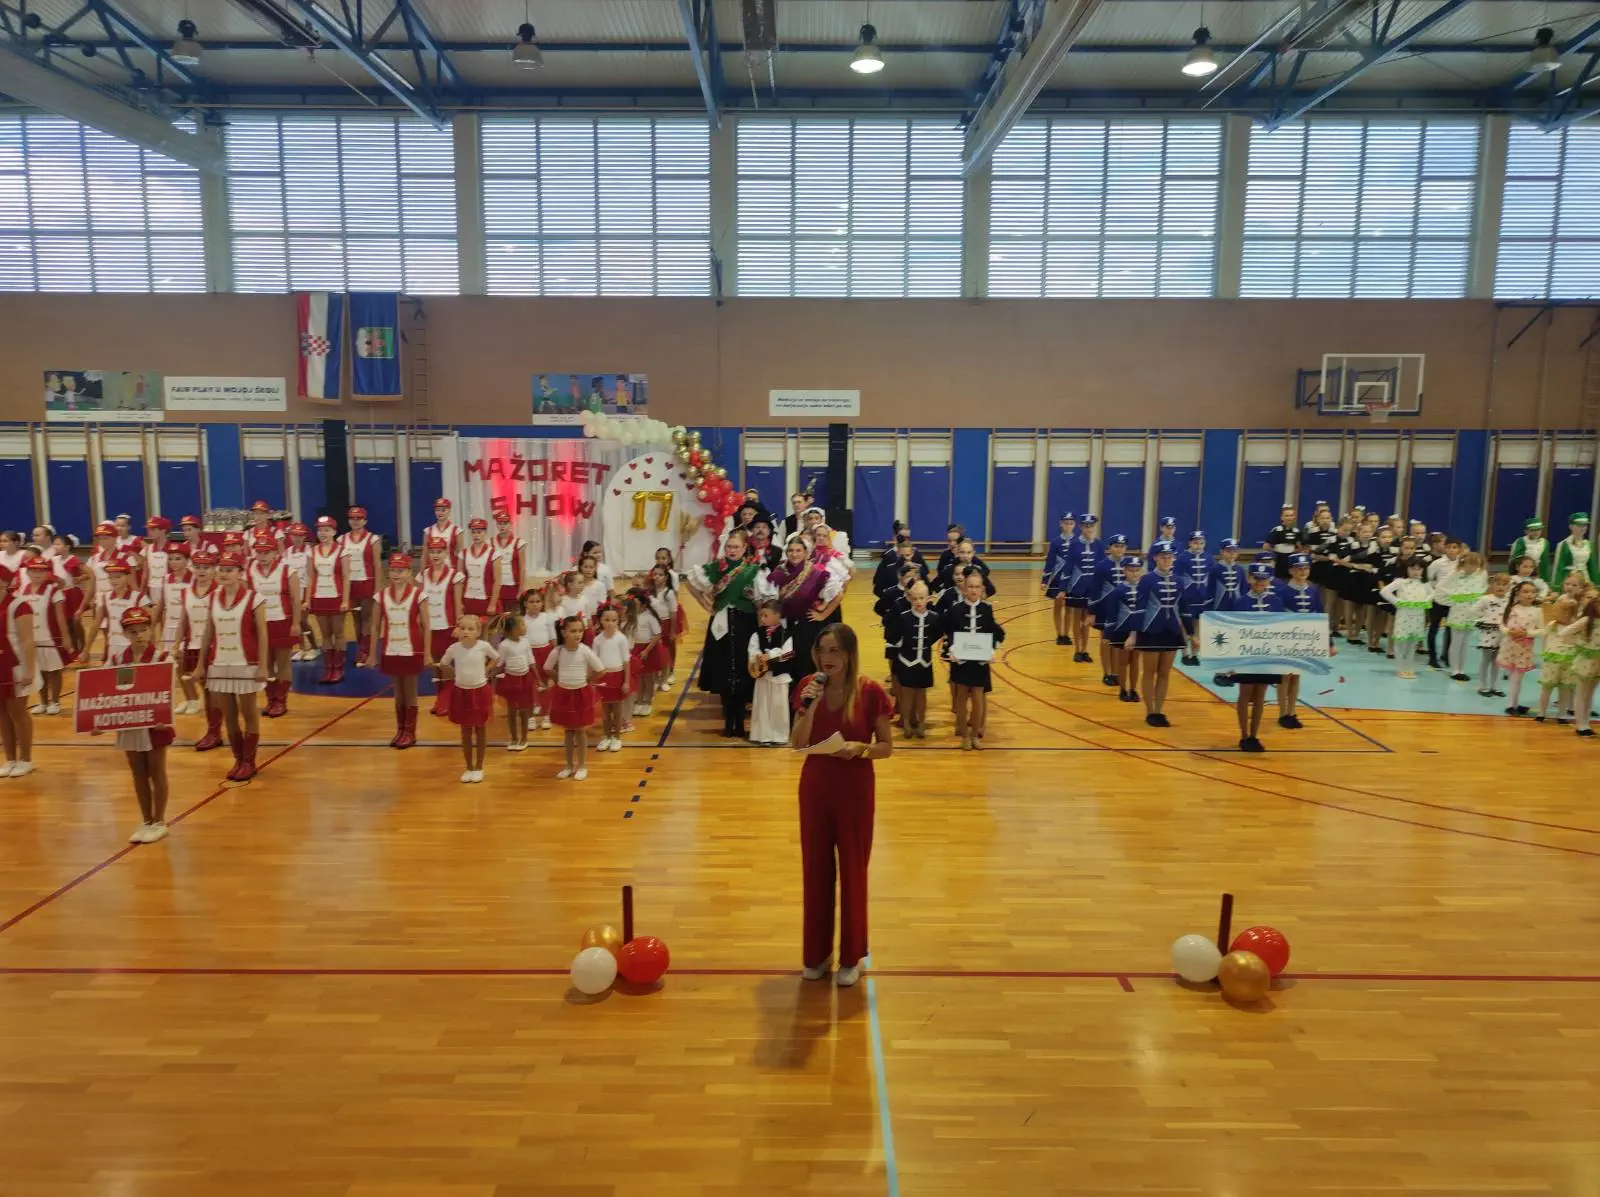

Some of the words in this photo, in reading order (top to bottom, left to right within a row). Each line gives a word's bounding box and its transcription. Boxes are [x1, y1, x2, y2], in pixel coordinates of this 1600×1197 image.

[464, 453, 611, 485] MAŽORET
[490, 493, 596, 519] SHOW
[631, 491, 674, 531] 17
[1238, 643, 1272, 657] Male
[79, 691, 169, 711] MAŽORETKINJE
[94, 709, 154, 726] KOTORIBE
